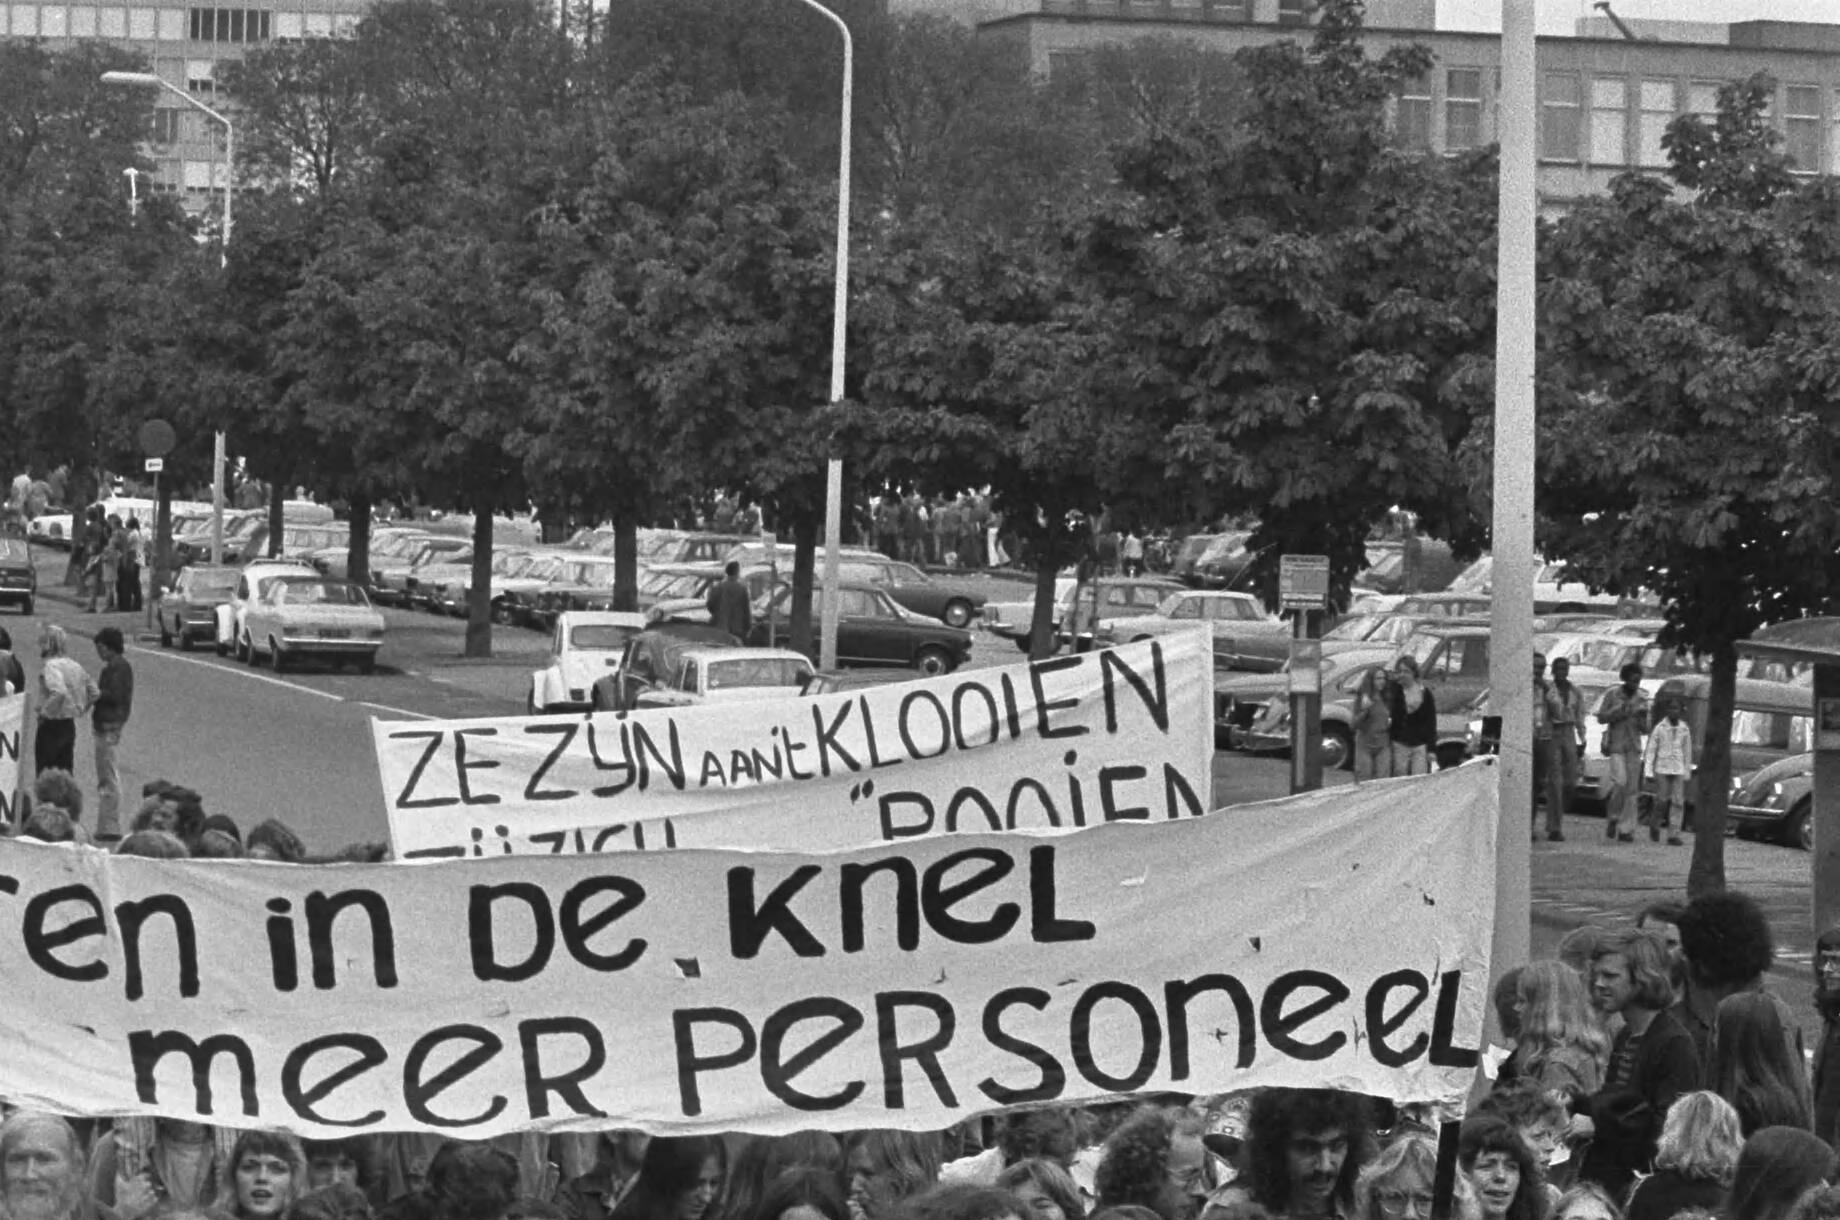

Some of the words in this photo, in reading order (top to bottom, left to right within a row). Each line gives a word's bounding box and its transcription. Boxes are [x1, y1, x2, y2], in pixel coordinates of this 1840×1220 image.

[389, 727, 502, 808] ZE
[811, 640, 1170, 778] KLOOIEN
[266, 888, 399, 992] in
[469, 874, 649, 982] De
